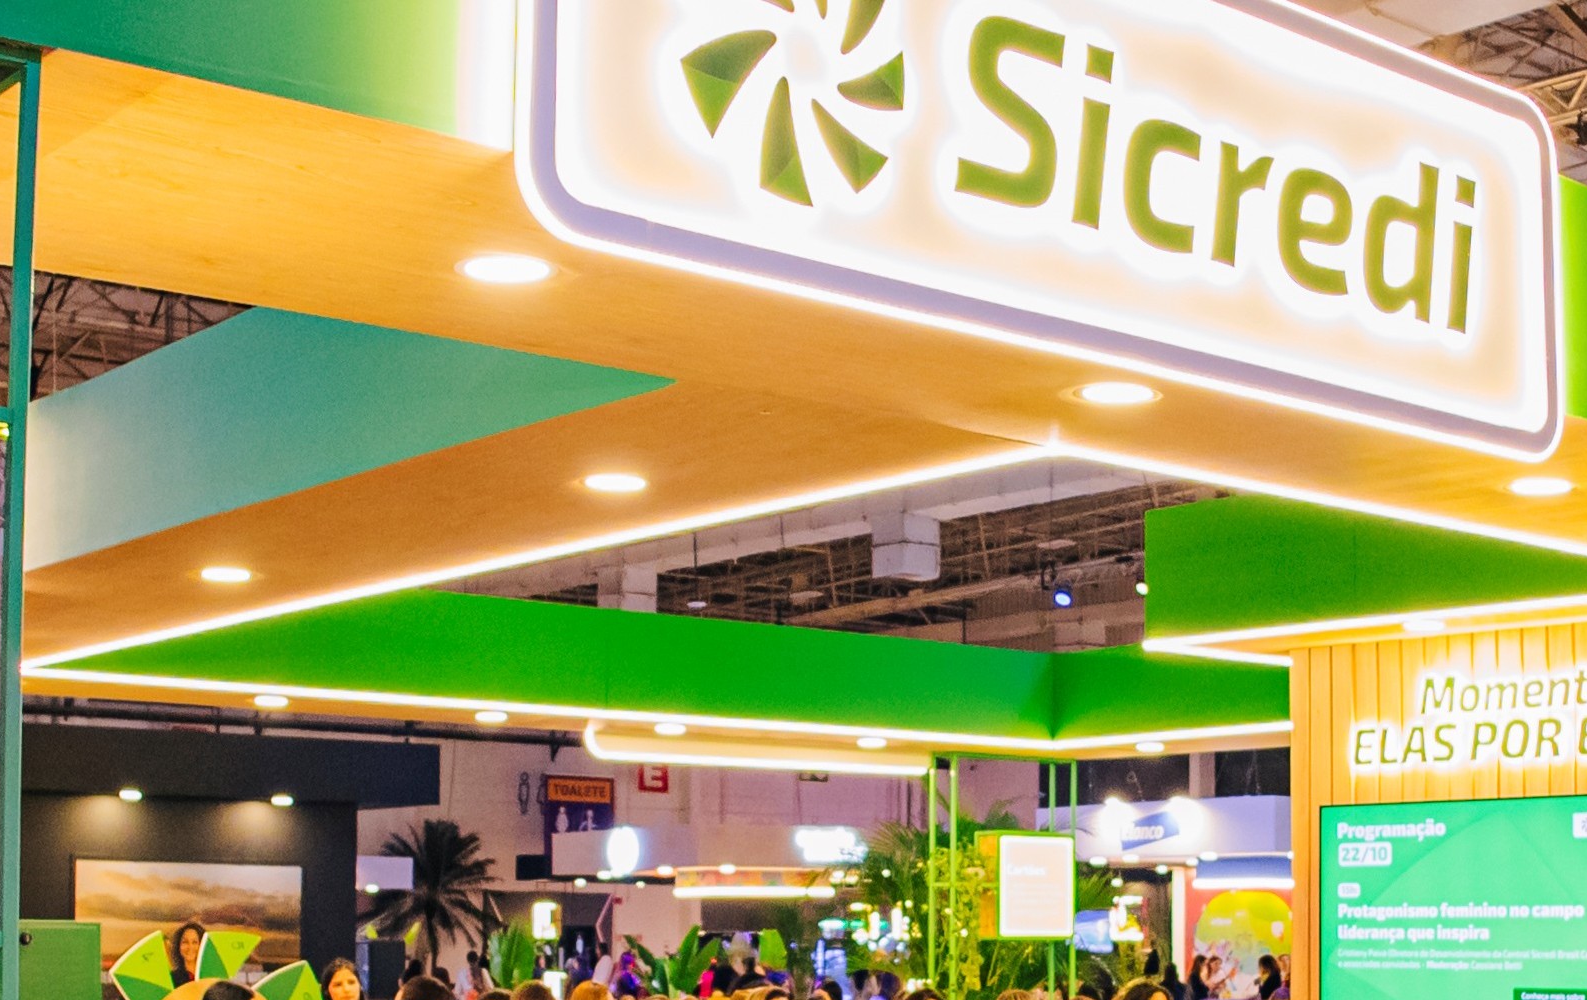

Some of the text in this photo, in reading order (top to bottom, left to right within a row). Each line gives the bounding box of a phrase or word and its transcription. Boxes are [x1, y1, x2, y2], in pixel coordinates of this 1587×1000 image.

[954, 13, 1477, 335] Sicredi
[1354, 724, 1457, 765] ELAS
[1471, 718, 1562, 761] POR
[1337, 818, 1447, 842] Programação
[1342, 846, 1388, 863] 22/10
[1337, 901, 1586, 921] Protagonismo feminino no campo
[1337, 924, 1490, 943] liderança que inspira
